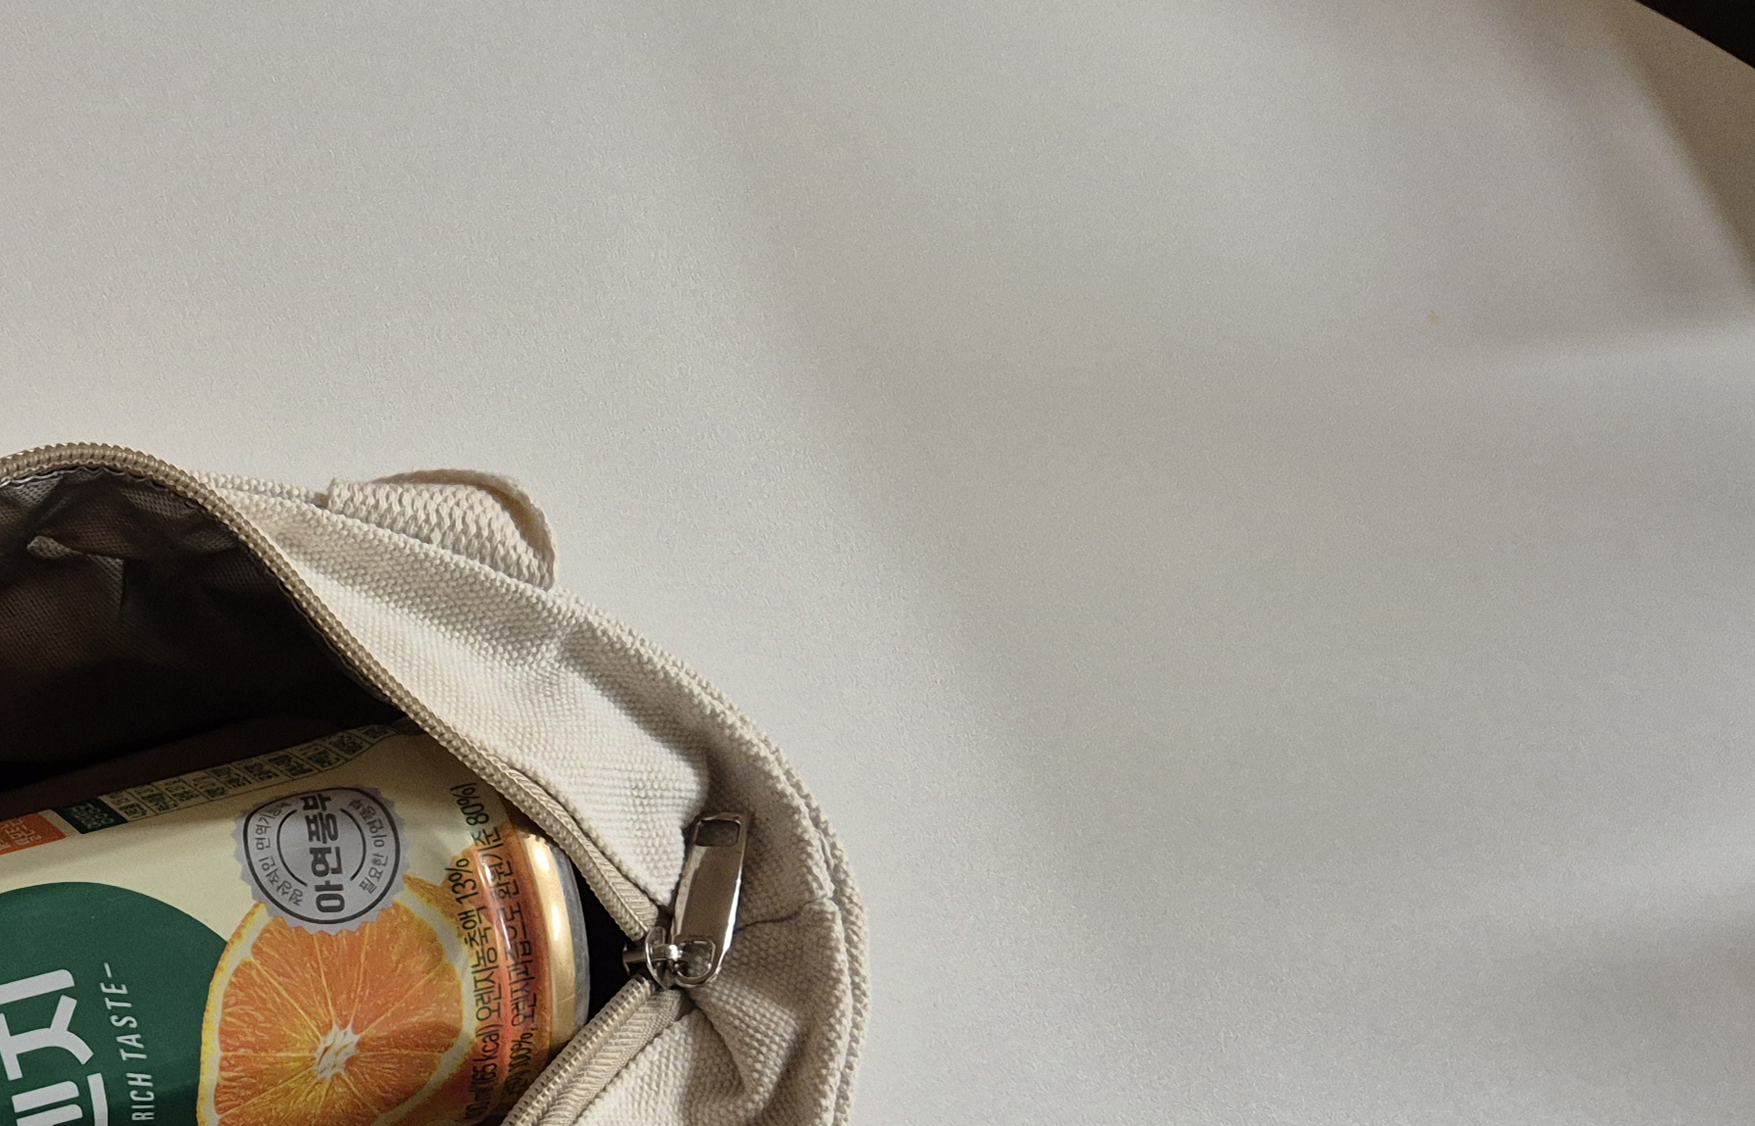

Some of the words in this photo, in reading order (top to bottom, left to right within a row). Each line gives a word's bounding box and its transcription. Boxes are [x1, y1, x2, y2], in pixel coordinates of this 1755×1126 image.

[449, 782, 491, 826] 80%)
[299, 793, 346, 913] 아연풍부
[358, 852, 389, 895] 필요한
[471, 826, 521, 900] 환원기준
[258, 855, 304, 906] 정상적인
[445, 858, 480, 905] 13%
[457, 906, 502, 1022] 오렌지농축액
[497, 901, 538, 1027] 오렌지과즙으로
[125, 1072, 156, 1121] RICH
